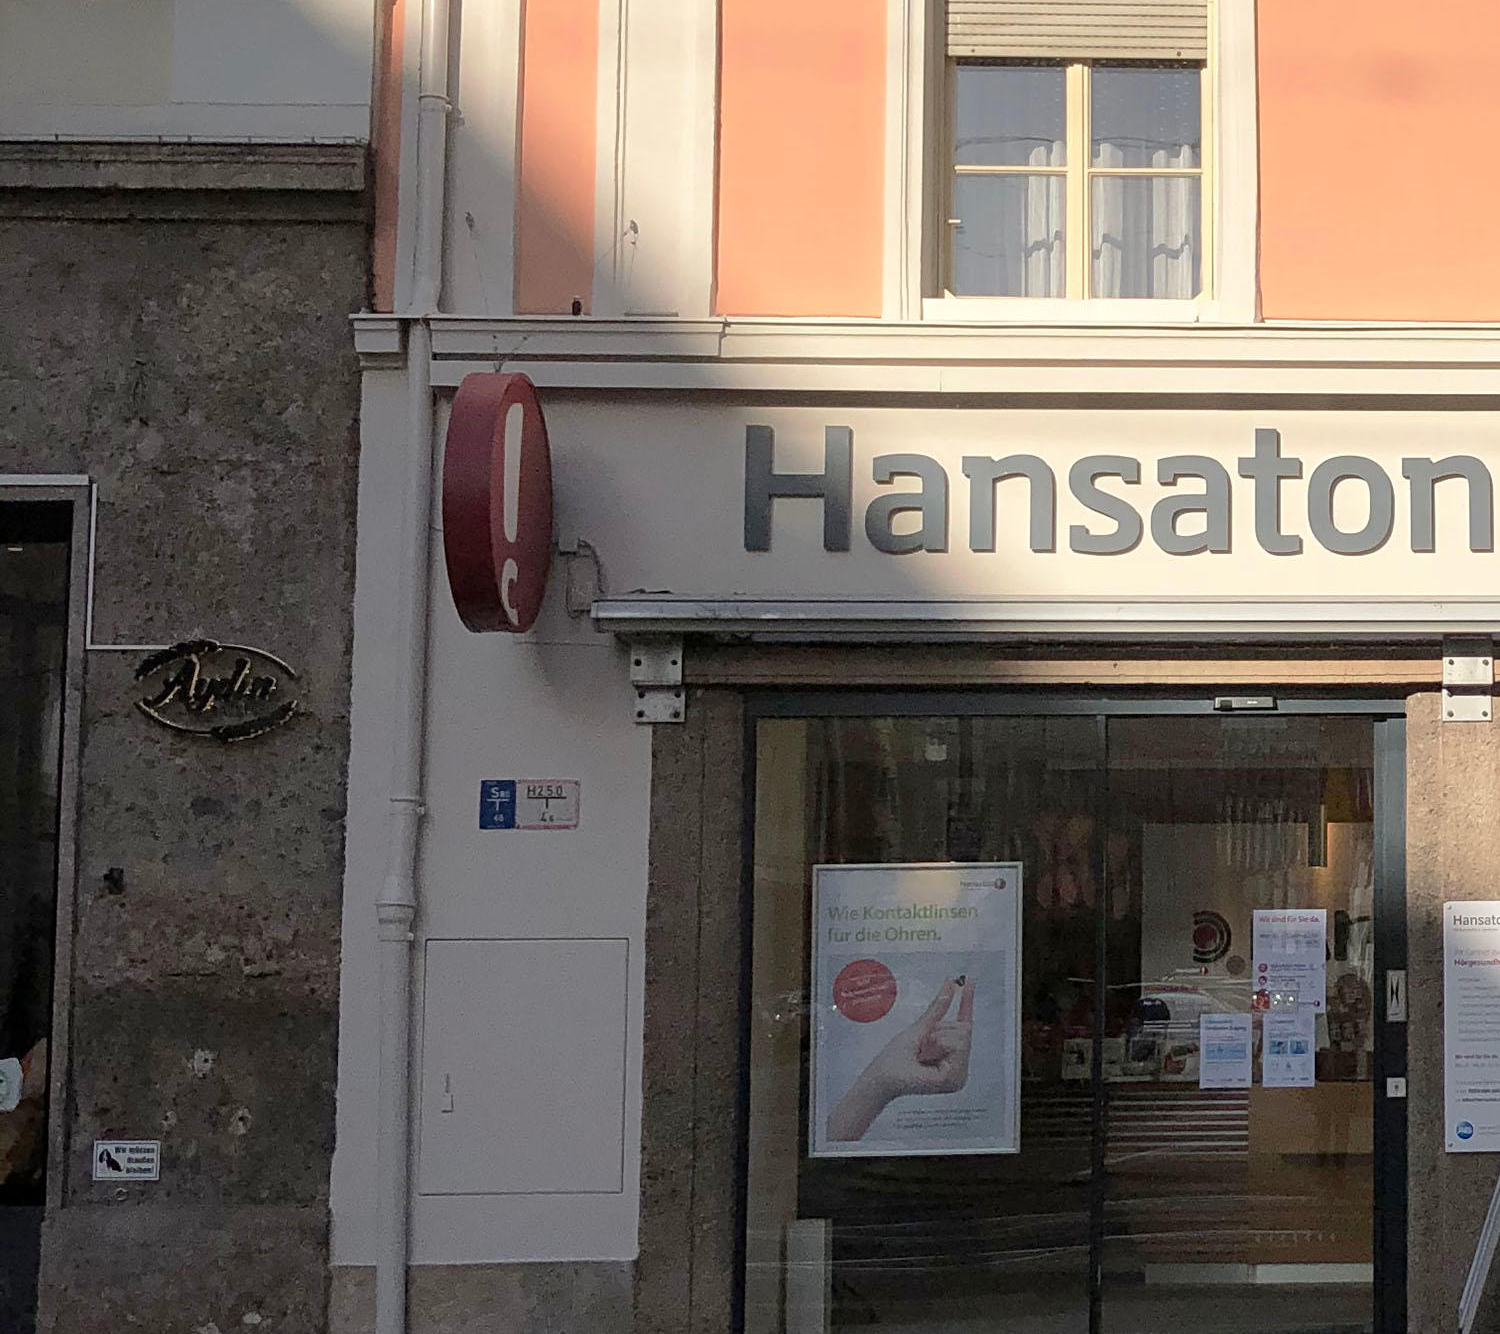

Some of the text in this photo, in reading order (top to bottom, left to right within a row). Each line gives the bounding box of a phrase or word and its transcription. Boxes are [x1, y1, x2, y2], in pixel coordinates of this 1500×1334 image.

[743, 424, 1494, 557] Hansaton
[828, 904, 978, 920] Wie Kontaktlinsen
[828, 927, 942, 942] für die Ohren.
